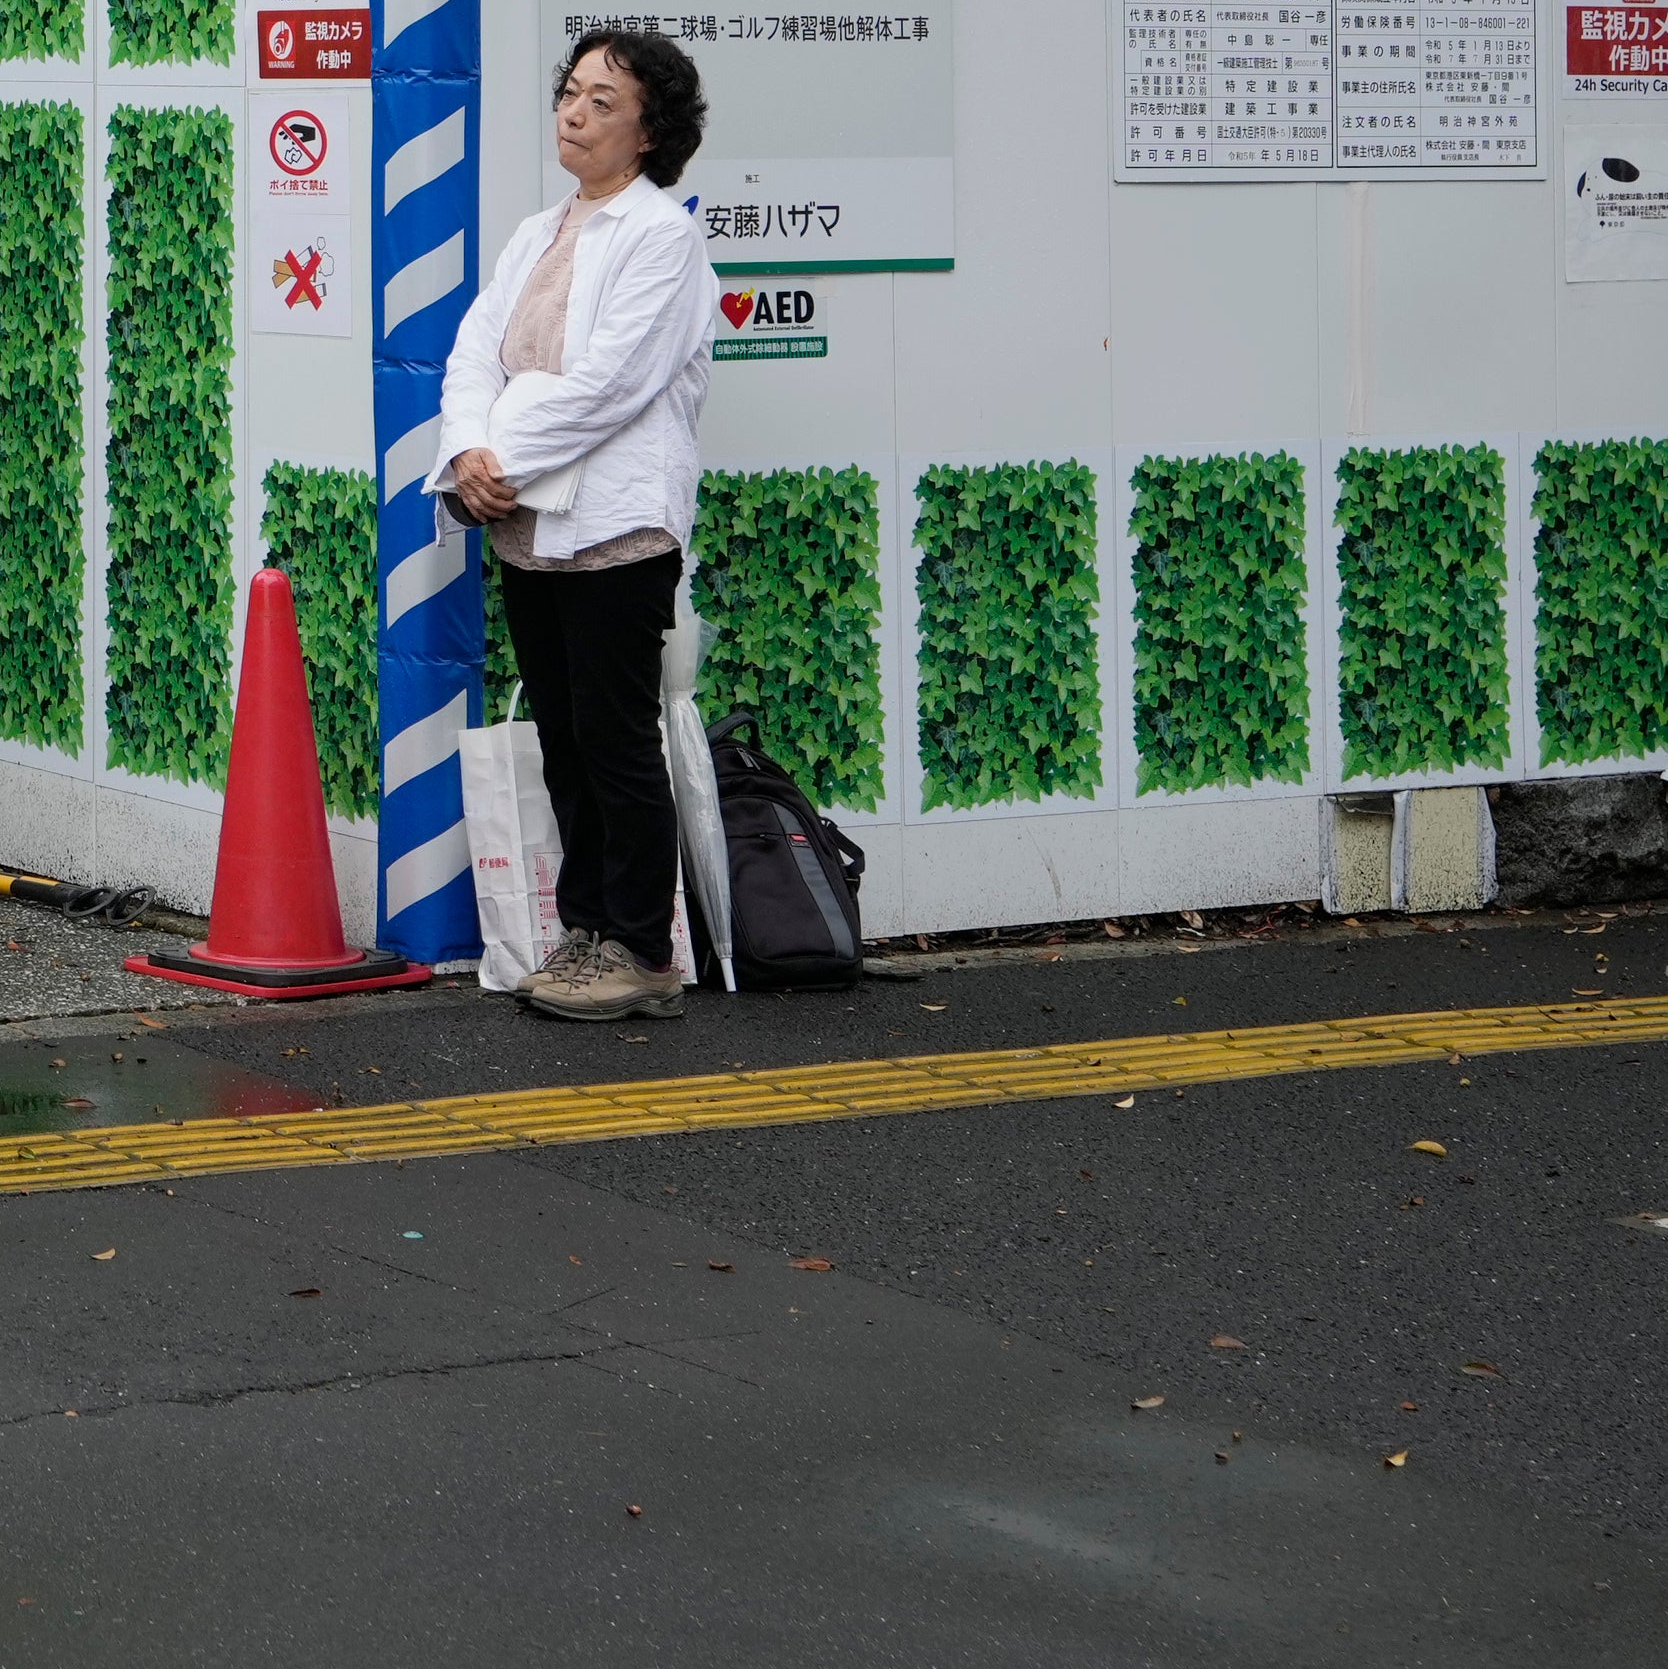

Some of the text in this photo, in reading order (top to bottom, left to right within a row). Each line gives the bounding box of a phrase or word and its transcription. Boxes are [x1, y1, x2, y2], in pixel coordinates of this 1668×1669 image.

[1130, 9, 1206, 23] 代表者の氏名
[1341, 16, 1415, 29] 労働保険番号
[305, 21, 363, 41] 監視カメラ
[1342, 45, 1415, 58] 事業の期間
[268, 61, 295, 69] WARNING
[316, 50, 351, 69] 作動中
[1342, 81, 1416, 94] 事業主の住所氏名
[1575, 79, 1596, 91] 24h
[1601, 79, 1649, 94] Security
[1130, 102, 1207, 116] 許可を受けた建設業
[1342, 115, 1416, 129] 注文者の氏名
[1130, 126, 1207, 139] 許可番号
[1130, 149, 1207, 162] 許可年月日
[745, 174, 760, 183] 施工
[270, 180, 328, 191] ポイ捨て禁止
[705, 201, 840, 239] 安藤ハザマ
[753, 291, 814, 324] AED
